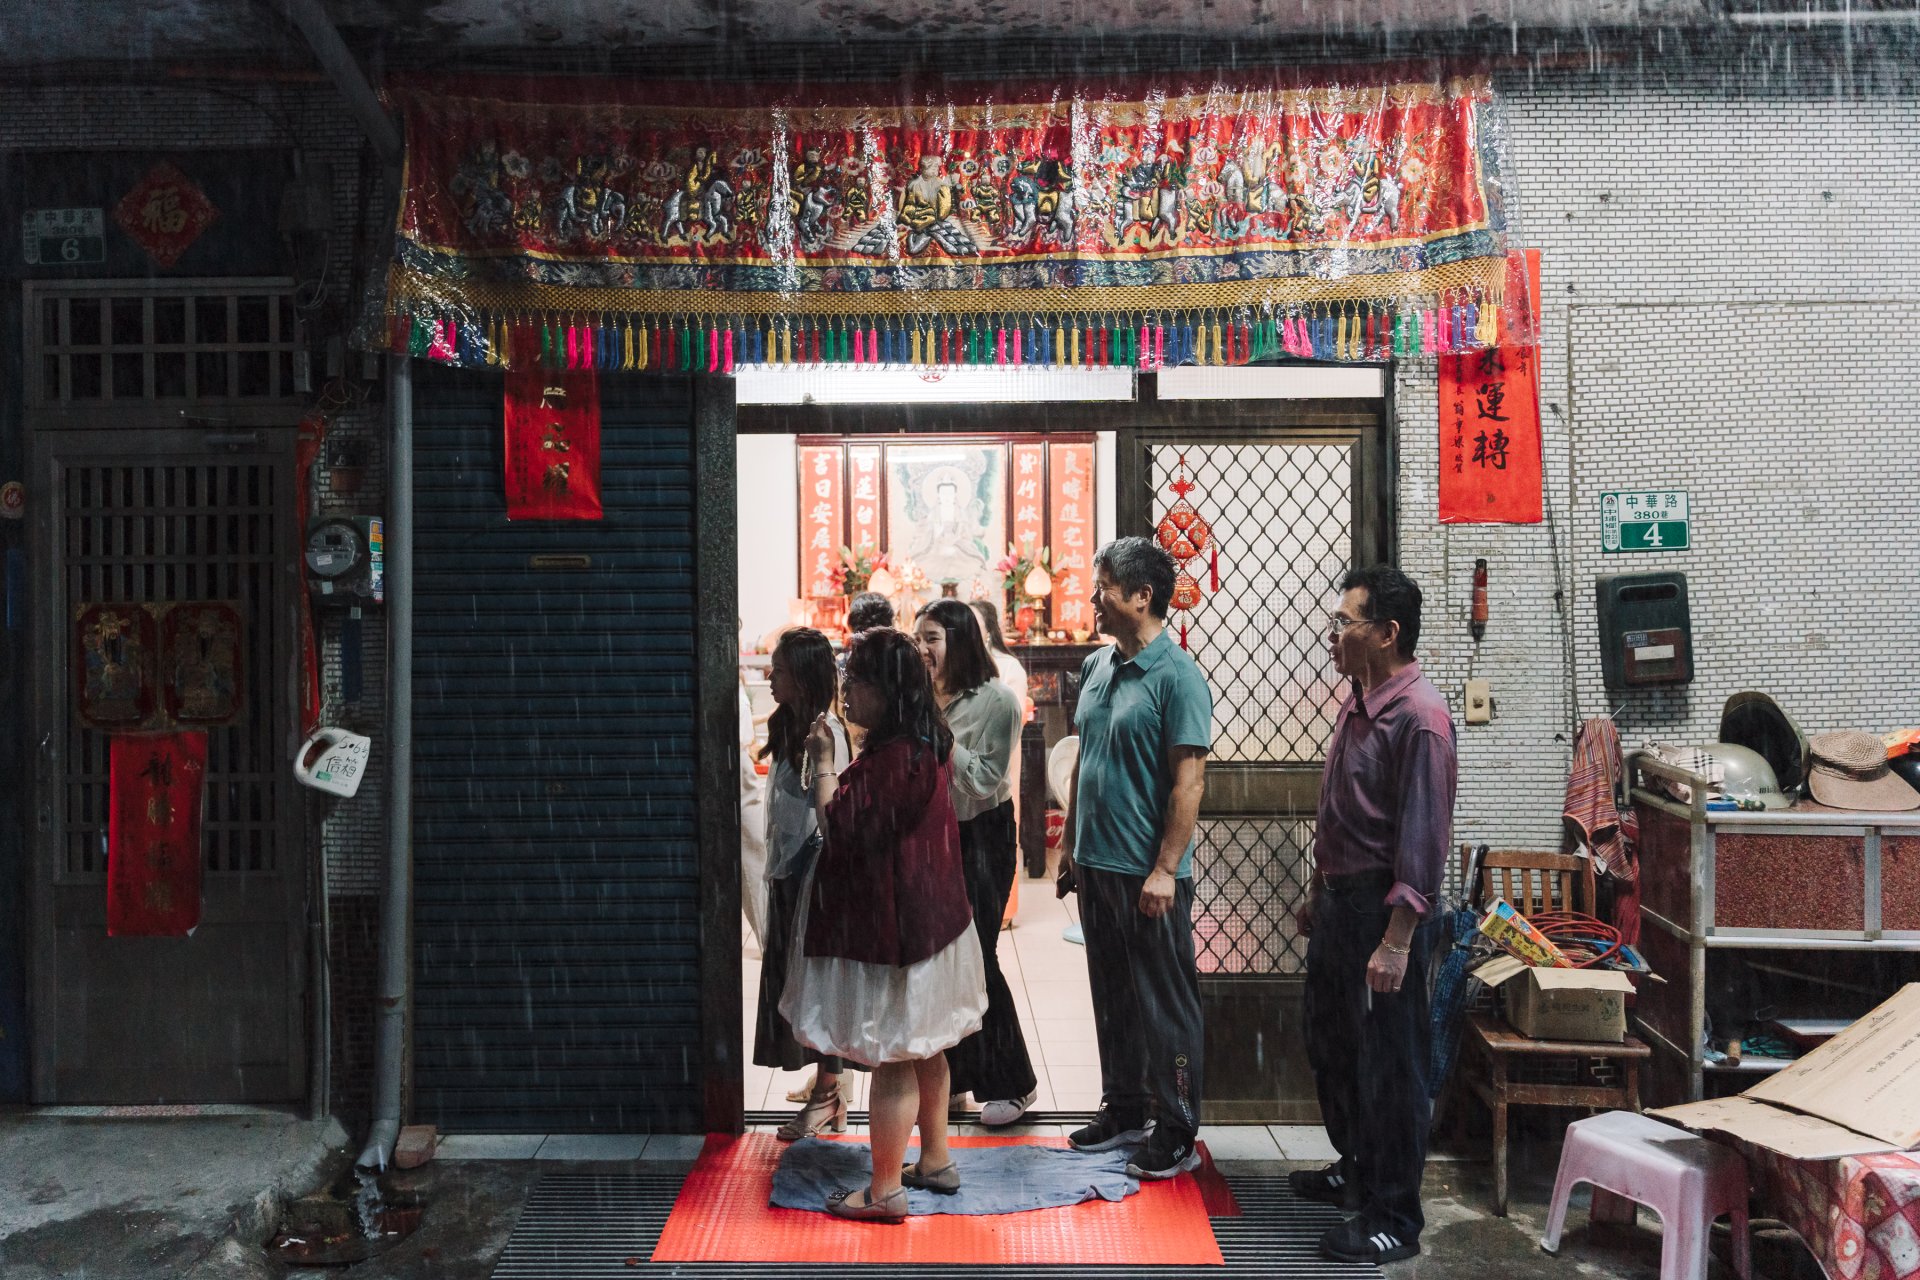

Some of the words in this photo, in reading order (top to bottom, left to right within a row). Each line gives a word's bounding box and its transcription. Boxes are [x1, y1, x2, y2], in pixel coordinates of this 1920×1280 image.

[141, 187, 188, 234] 福
[62, 238, 80, 261] 6
[1626, 495, 1678, 508] 中華路
[1634, 510, 1669, 520] 380巷
[1643, 522, 1663, 547] 4
[1173, 1145, 1186, 1160] FILA
